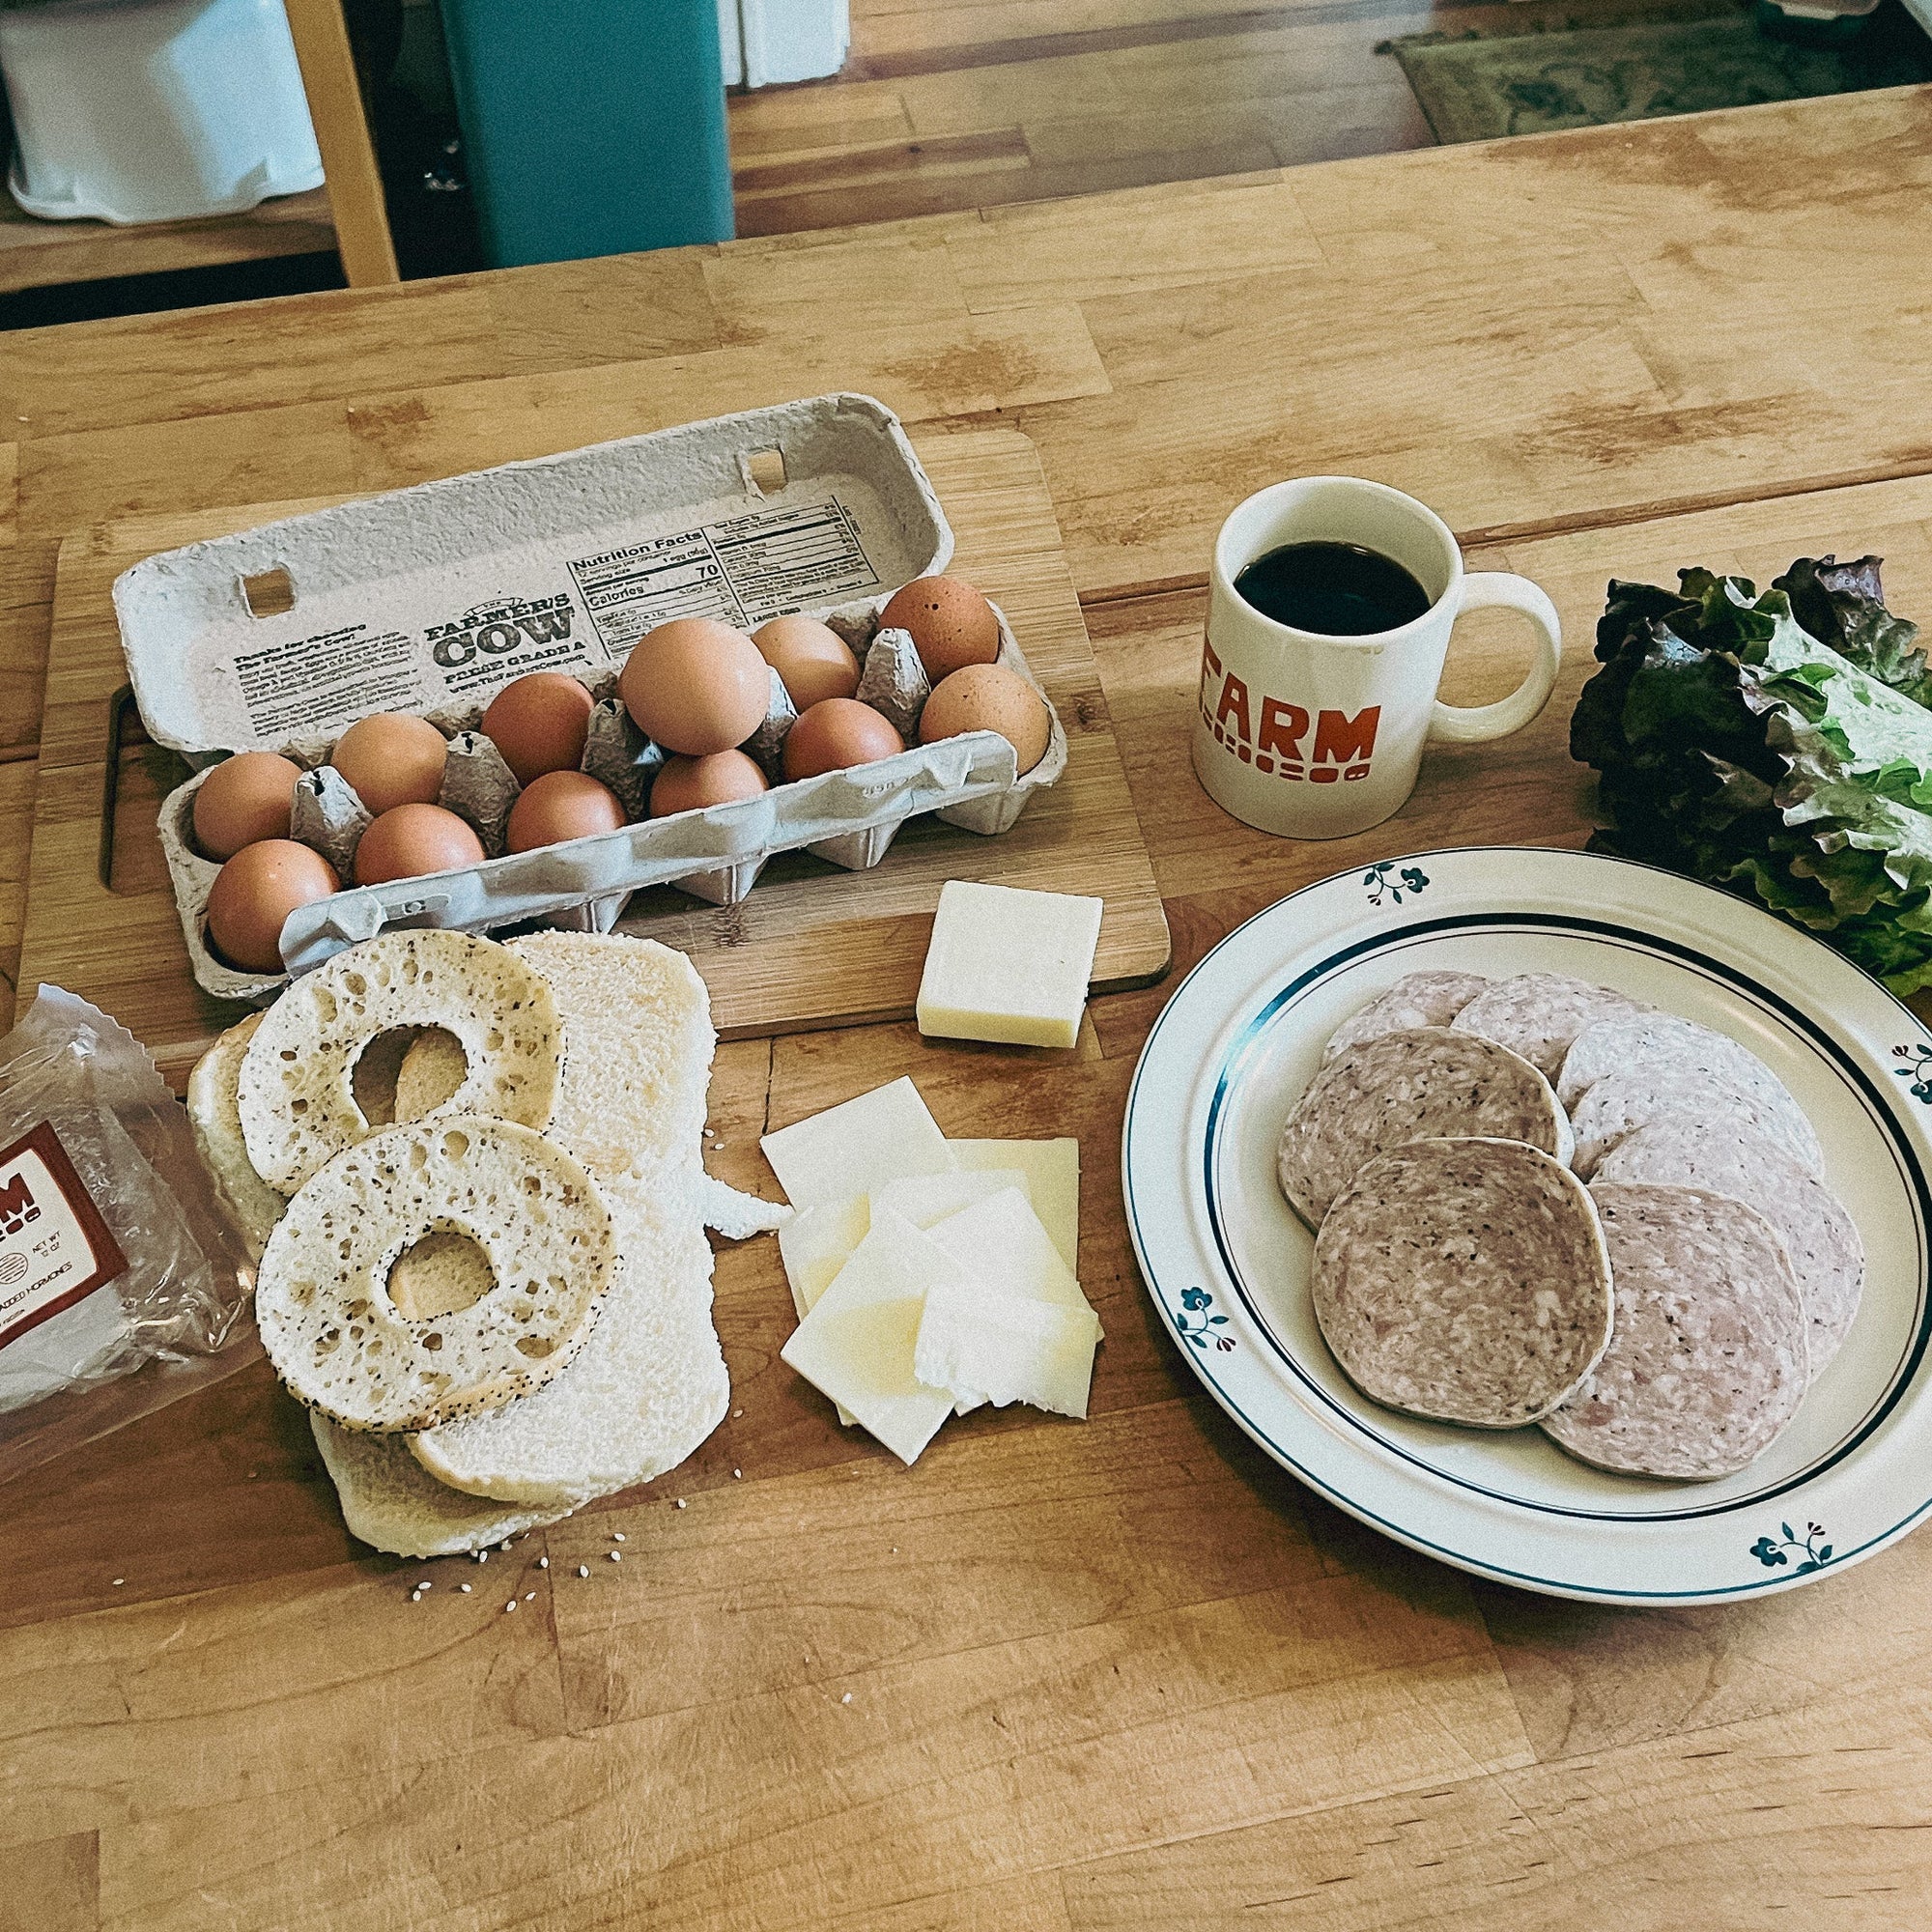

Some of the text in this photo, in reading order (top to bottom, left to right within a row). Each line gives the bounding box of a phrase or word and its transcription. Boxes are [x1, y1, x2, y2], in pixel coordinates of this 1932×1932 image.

[573, 531, 703, 571] Nutrition Facts
[588, 585, 645, 607] Calories
[696, 564, 719, 579] 70
[432, 606, 577, 668] COW
[233, 645, 282, 665] Thanks
[284, 639, 305, 650] for
[507, 644, 571, 667] GRADE
[573, 641, 586, 651] A
[236, 660, 261, 671] The
[32, 1231, 61, 1254] NET WT
[50, 1241, 61, 1252] OZ
[26, 1261, 72, 1294] HORMONES
